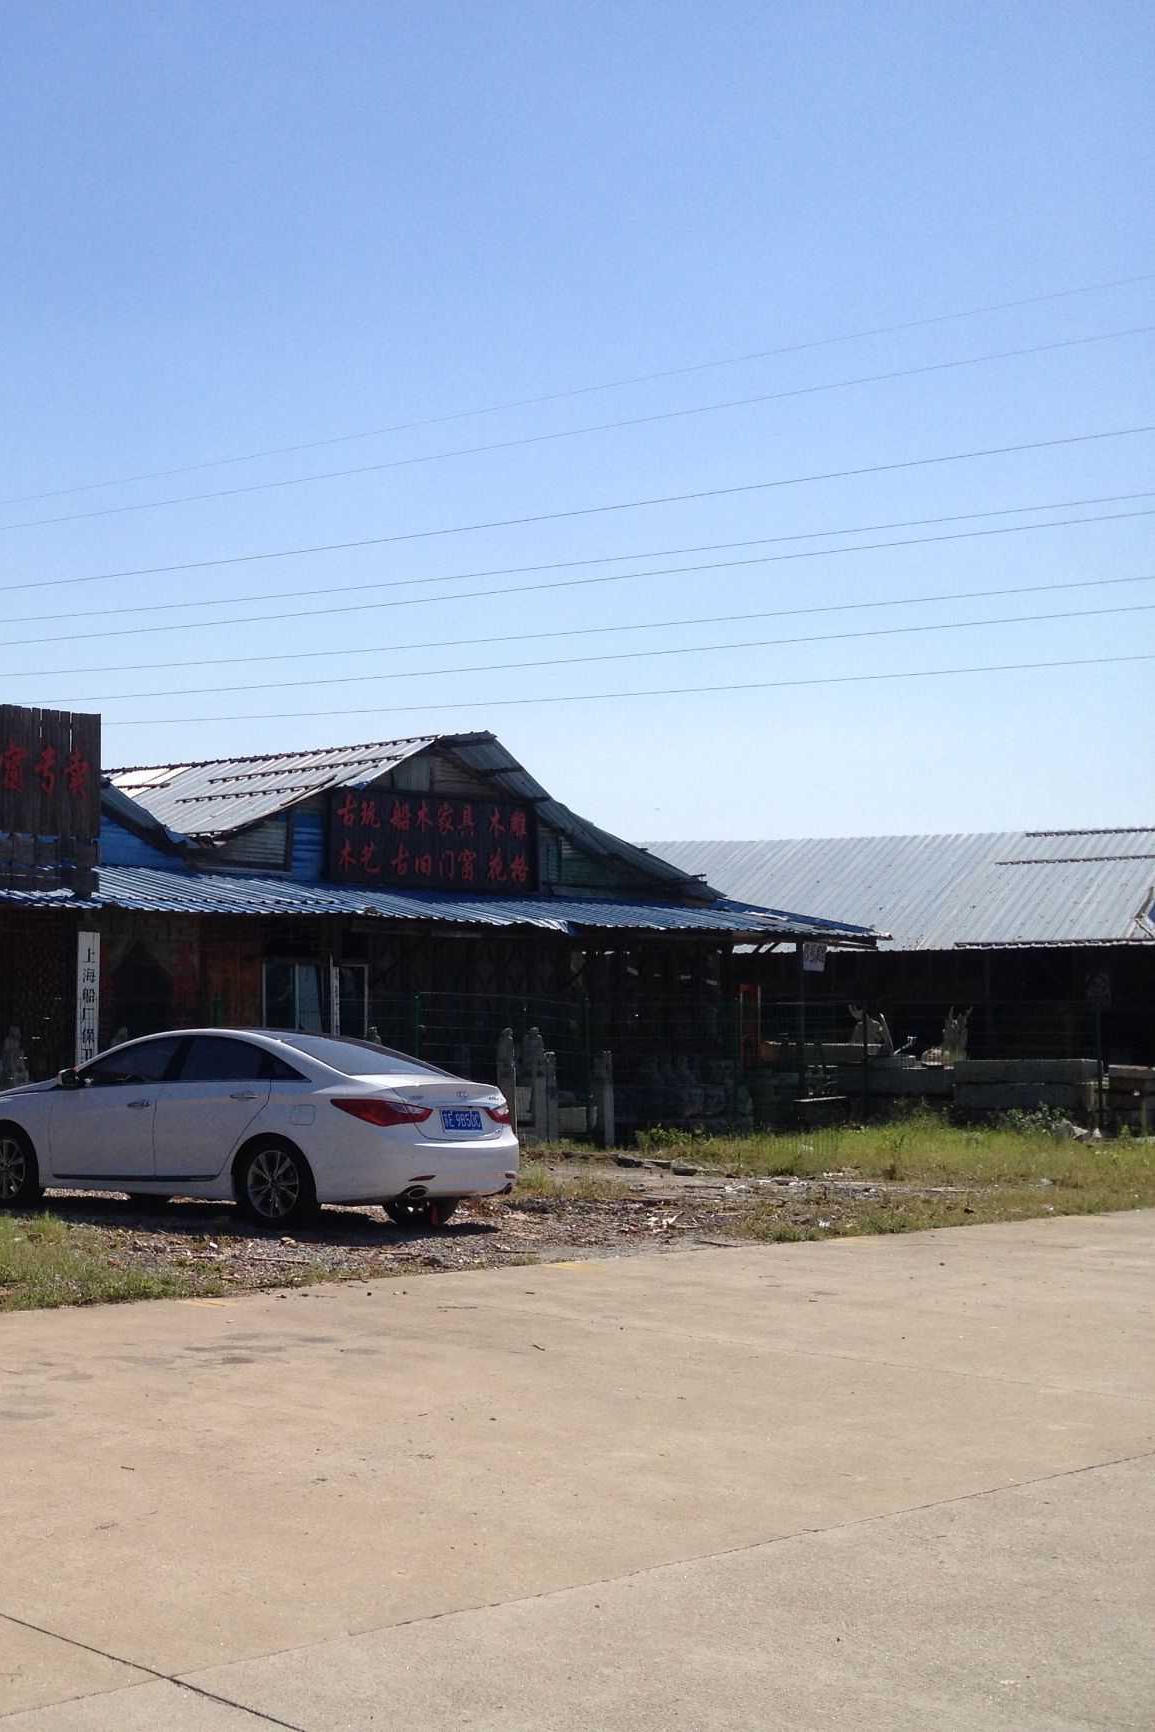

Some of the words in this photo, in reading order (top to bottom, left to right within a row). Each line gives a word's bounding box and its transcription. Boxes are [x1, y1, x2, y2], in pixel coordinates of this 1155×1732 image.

[336, 792, 382, 829] 古玩
[389, 799, 476, 837] 船木家具
[487, 807, 528, 840] 木雕
[338, 838, 383, 874] 木艺
